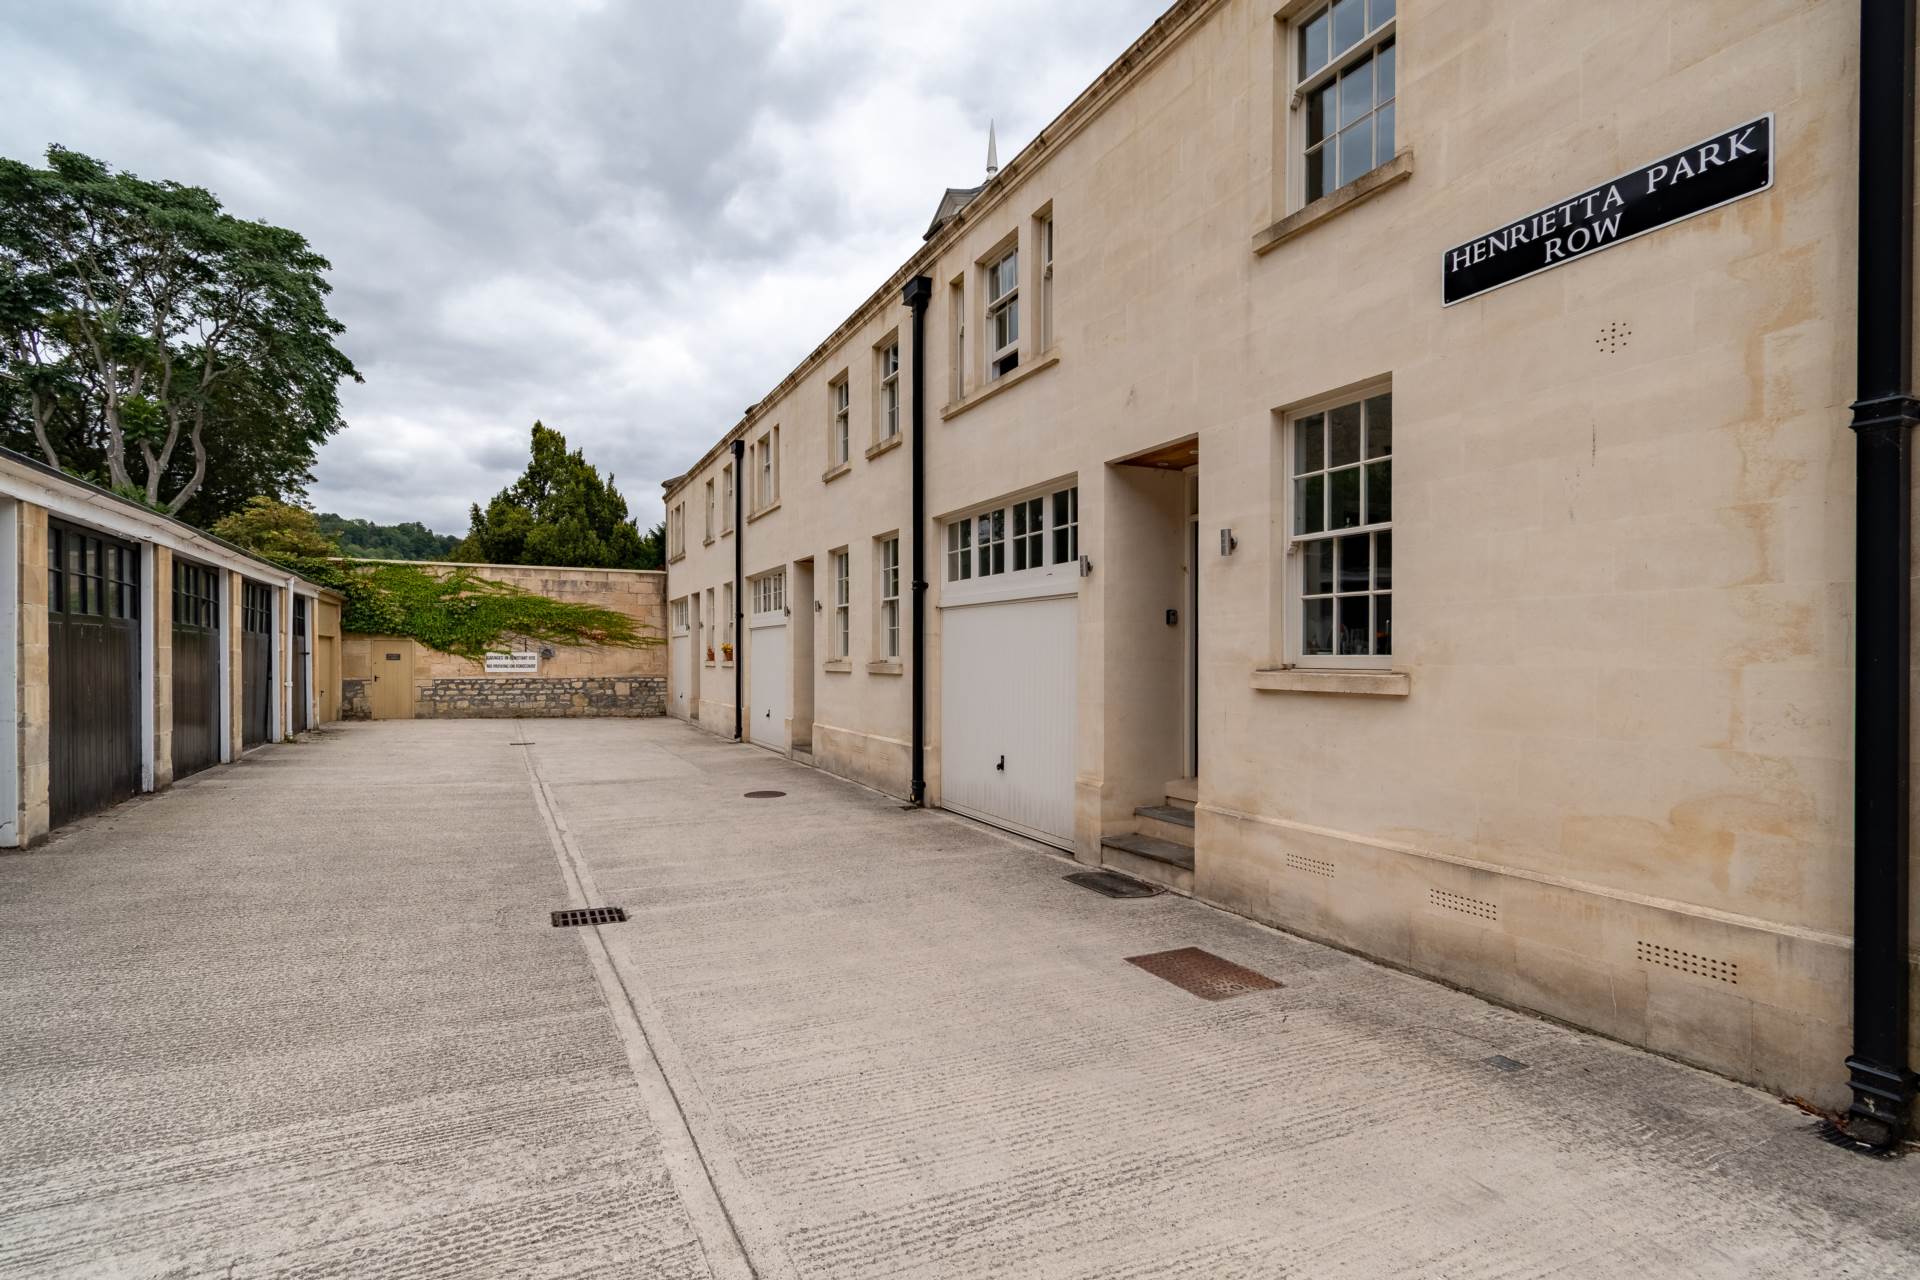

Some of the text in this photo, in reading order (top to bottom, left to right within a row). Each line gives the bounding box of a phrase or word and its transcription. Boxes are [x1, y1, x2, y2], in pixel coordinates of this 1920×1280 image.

[1451, 126, 1757, 272] HENRIETTA PARK
[1544, 212, 1623, 263] ROW
